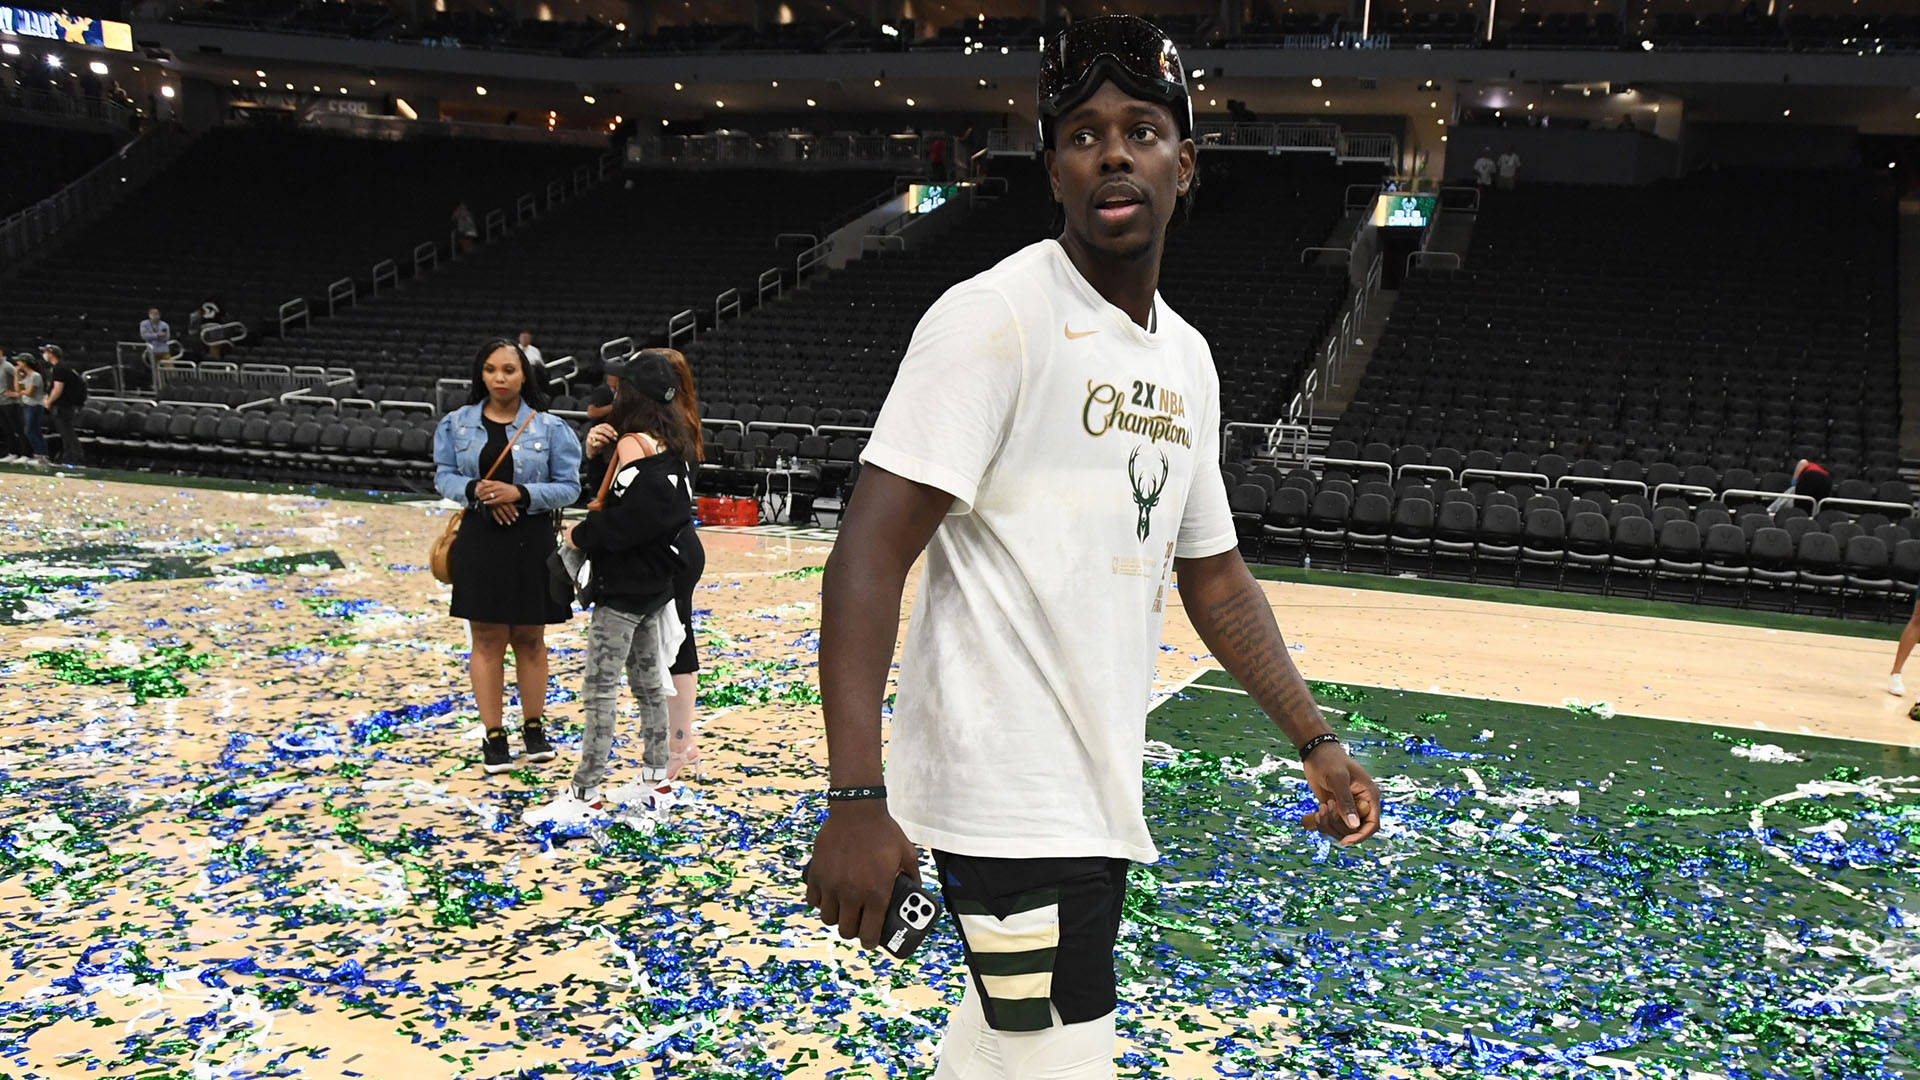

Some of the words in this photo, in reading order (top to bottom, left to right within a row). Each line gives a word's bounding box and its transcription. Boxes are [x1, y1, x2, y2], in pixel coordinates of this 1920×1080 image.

[1083, 379, 1192, 449] Champions
[1131, 380, 1156, 410] 2X
[1160, 387, 1185, 418] NBA
